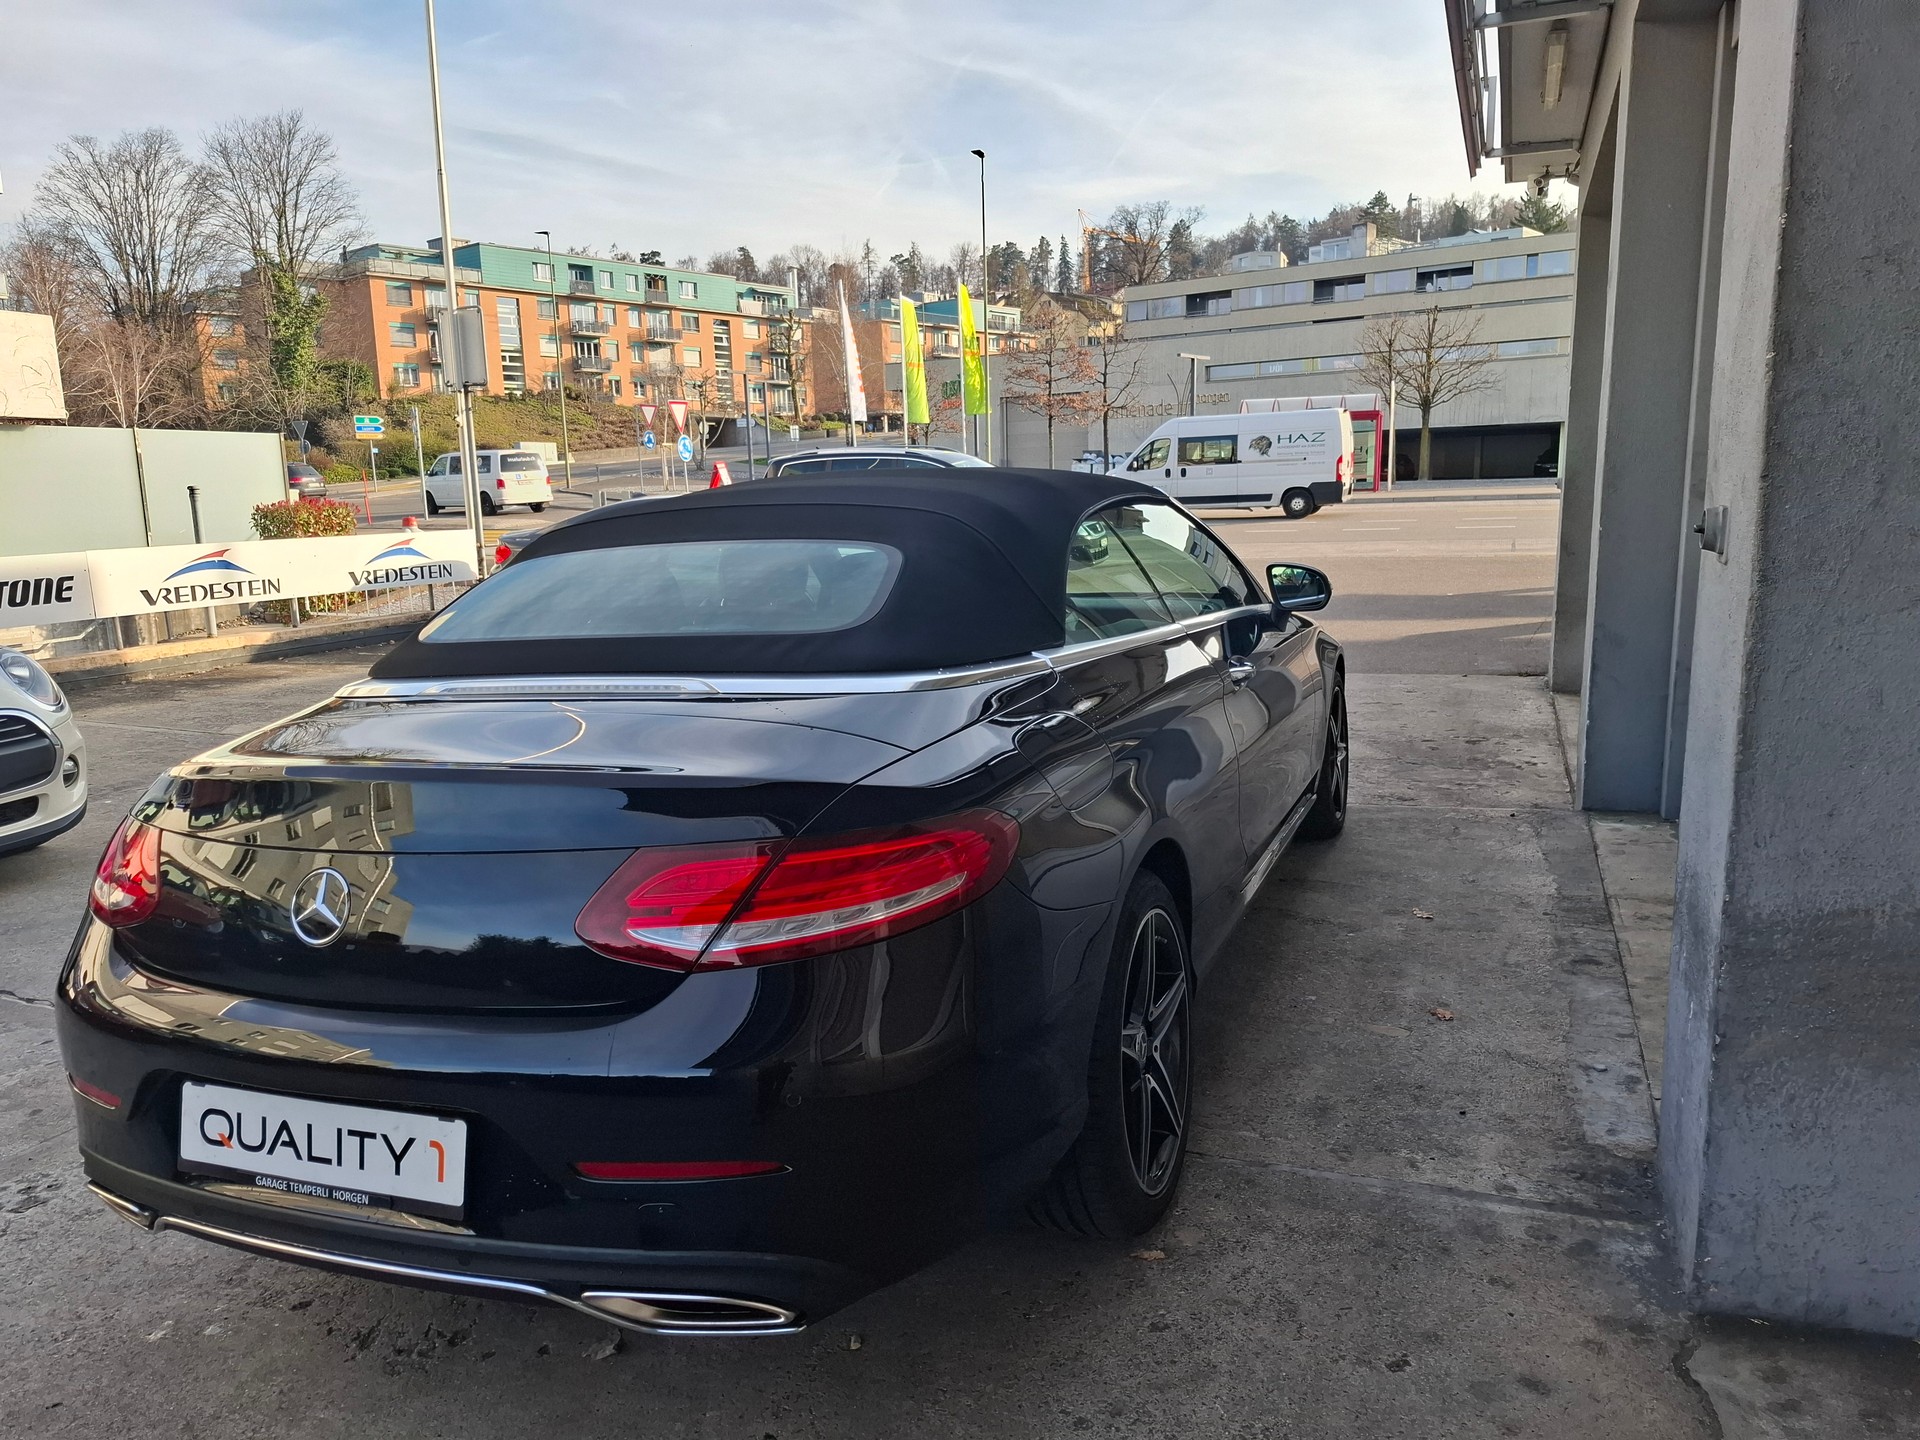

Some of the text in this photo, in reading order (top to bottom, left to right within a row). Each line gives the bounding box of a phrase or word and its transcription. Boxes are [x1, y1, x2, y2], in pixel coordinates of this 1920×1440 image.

[1277, 431, 1326, 444] HAZ
[348, 563, 453, 586] VREDESTEIN
[140, 578, 281, 607] VREDESTEIN
[199, 1108, 417, 1176] QUALITY
[255, 1175, 369, 1206] GARAGE TEMPERLI HORGEN
